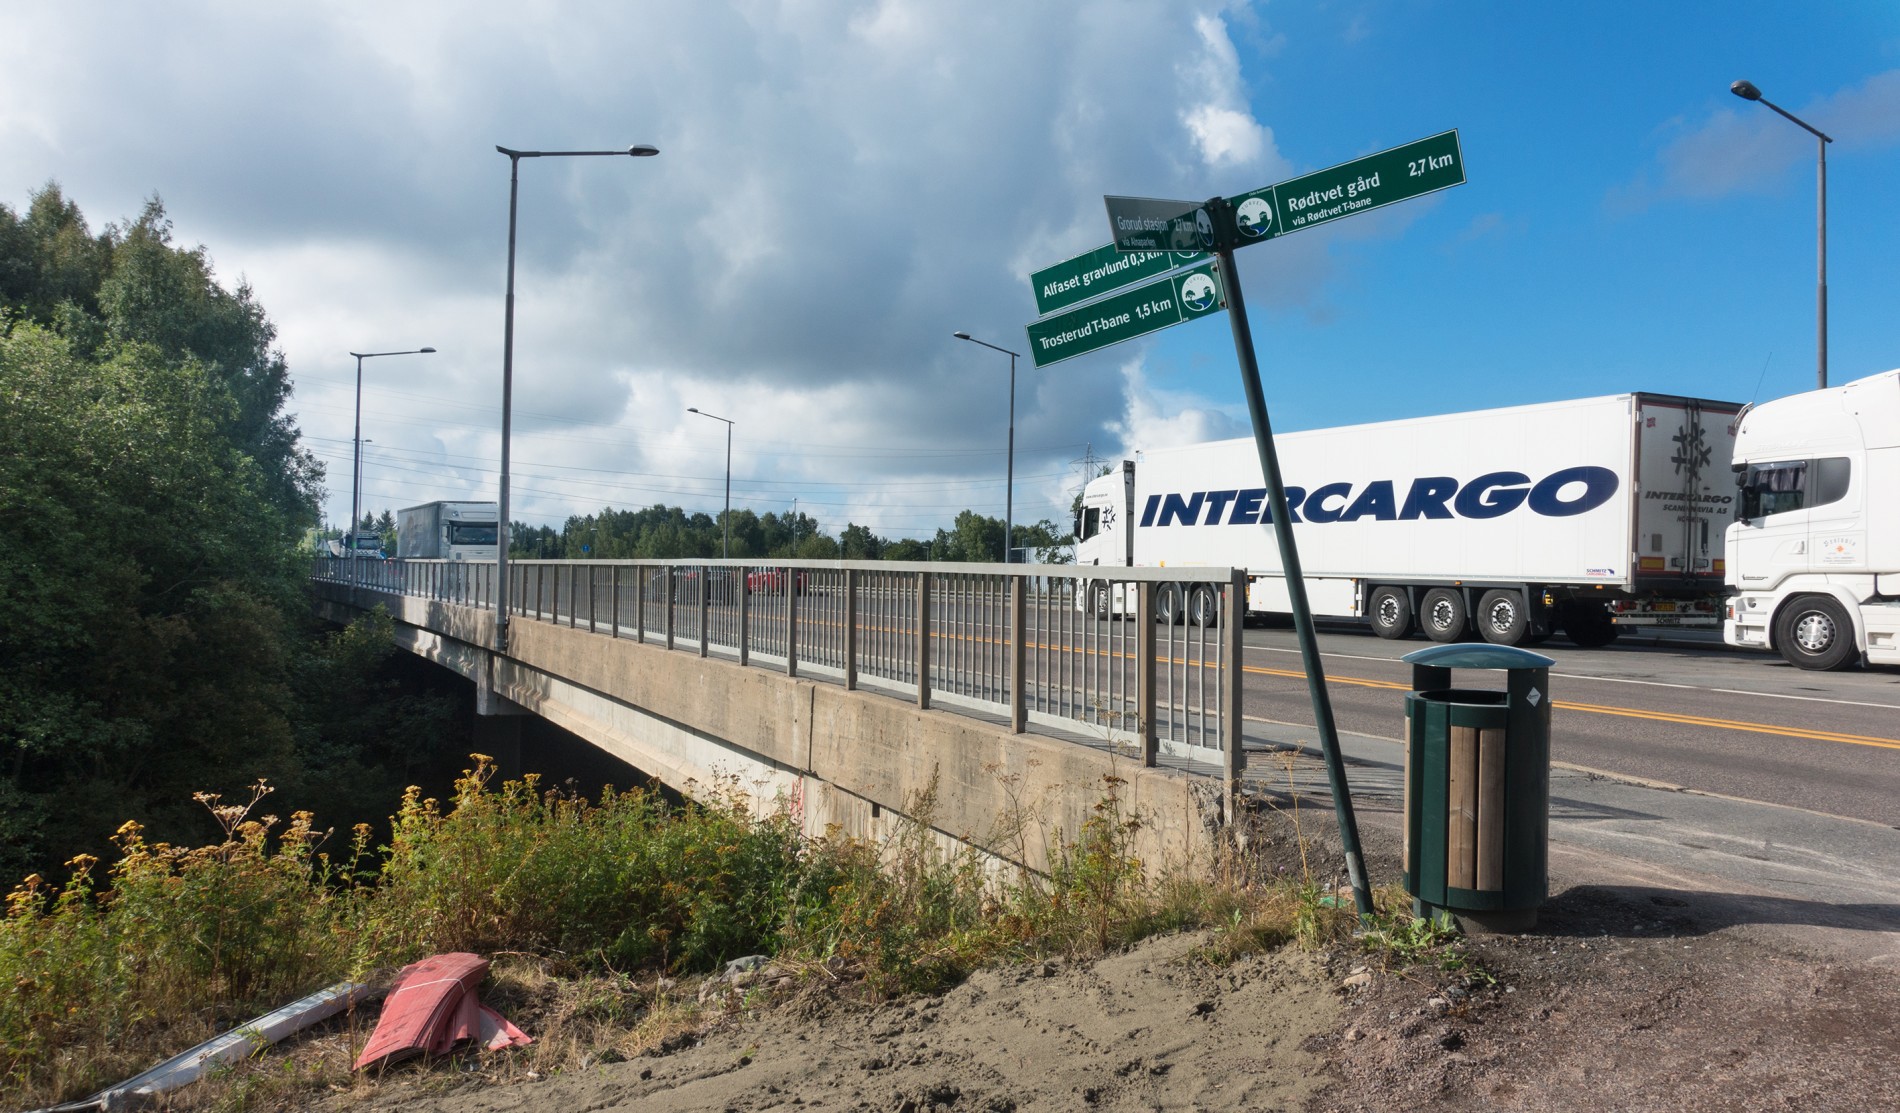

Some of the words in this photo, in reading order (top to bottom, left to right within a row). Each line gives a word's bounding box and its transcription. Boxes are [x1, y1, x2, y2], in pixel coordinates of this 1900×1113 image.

[1287, 184, 1343, 212] Rødtvet
[1347, 172, 1381, 198] gård
[1408, 159, 1426, 178] 2,7
[1429, 153, 1454, 171] km
[1117, 215, 1143, 231] Grorud
[1143, 217, 1169, 234] stasjon
[1292, 214, 1306, 226] via
[1307, 205, 1342, 222] Rødtvet
[1342, 197, 1372, 213] T-bane
[1121, 237, 1130, 247] via
[1043, 276, 1080, 299] Alfaset
[1082, 257, 1130, 285] gravlund
[1129, 251, 1146, 267] 0,3
[1040, 323, 1092, 350] Trosterud
[1091, 312, 1130, 334] T-bane
[1135, 304, 1152, 320] 1,5
[1152, 298, 1172, 314] km
[1139, 465, 1620, 528] INTERCARGO
[1645, 491, 1733, 504] INTERCARGO
[1716, 507, 1728, 515] AS
